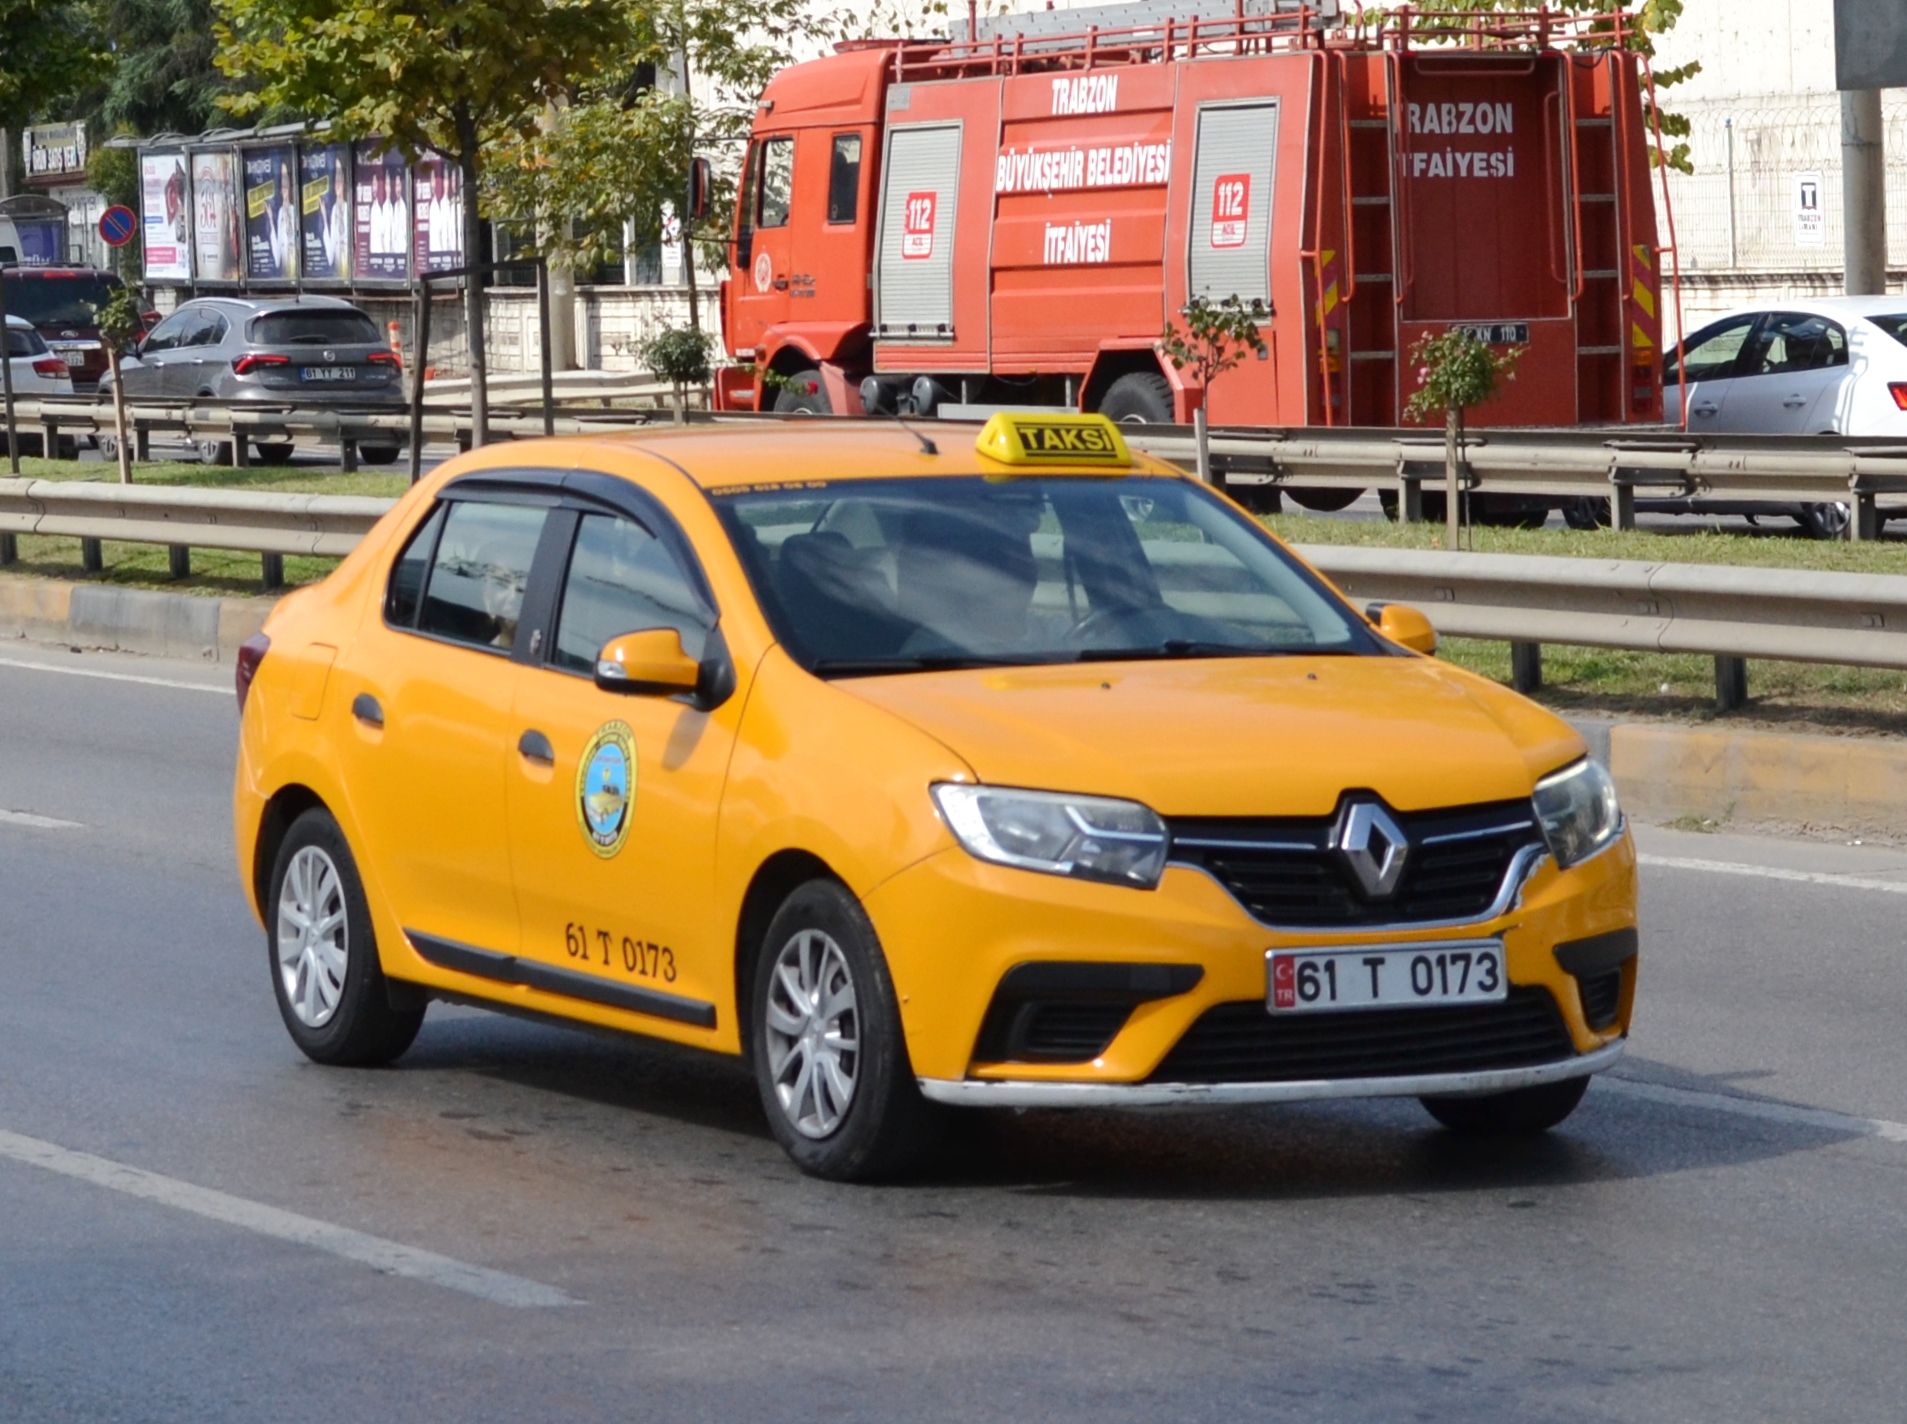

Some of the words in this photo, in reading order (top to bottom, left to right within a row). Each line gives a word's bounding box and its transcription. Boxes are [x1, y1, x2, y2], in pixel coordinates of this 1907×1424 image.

[1052, 74, 1118, 115] TRABZON
[995, 146, 1085, 192] BÜYÜKŞEHİR
[1087, 138, 1172, 186] BELEDİYESİ
[1396, 146, 1514, 178] FAİYESİ
[909, 198, 932, 230] 112
[1218, 181, 1244, 217] 112
[1043, 218, 1112, 264] İTFAİYESİ
[1501, 325, 1516, 341] 110
[306, 368, 316, 378] 61
[340, 368, 355, 378] 211
[565, 922, 590, 961] 61
[596, 929, 613, 966] T
[622, 936, 677, 983] 0173
[1276, 988, 1294, 1001] TR
[1297, 960, 1337, 1002] 61
[1362, 957, 1386, 999] T
[1410, 951, 1500, 997] 0173
